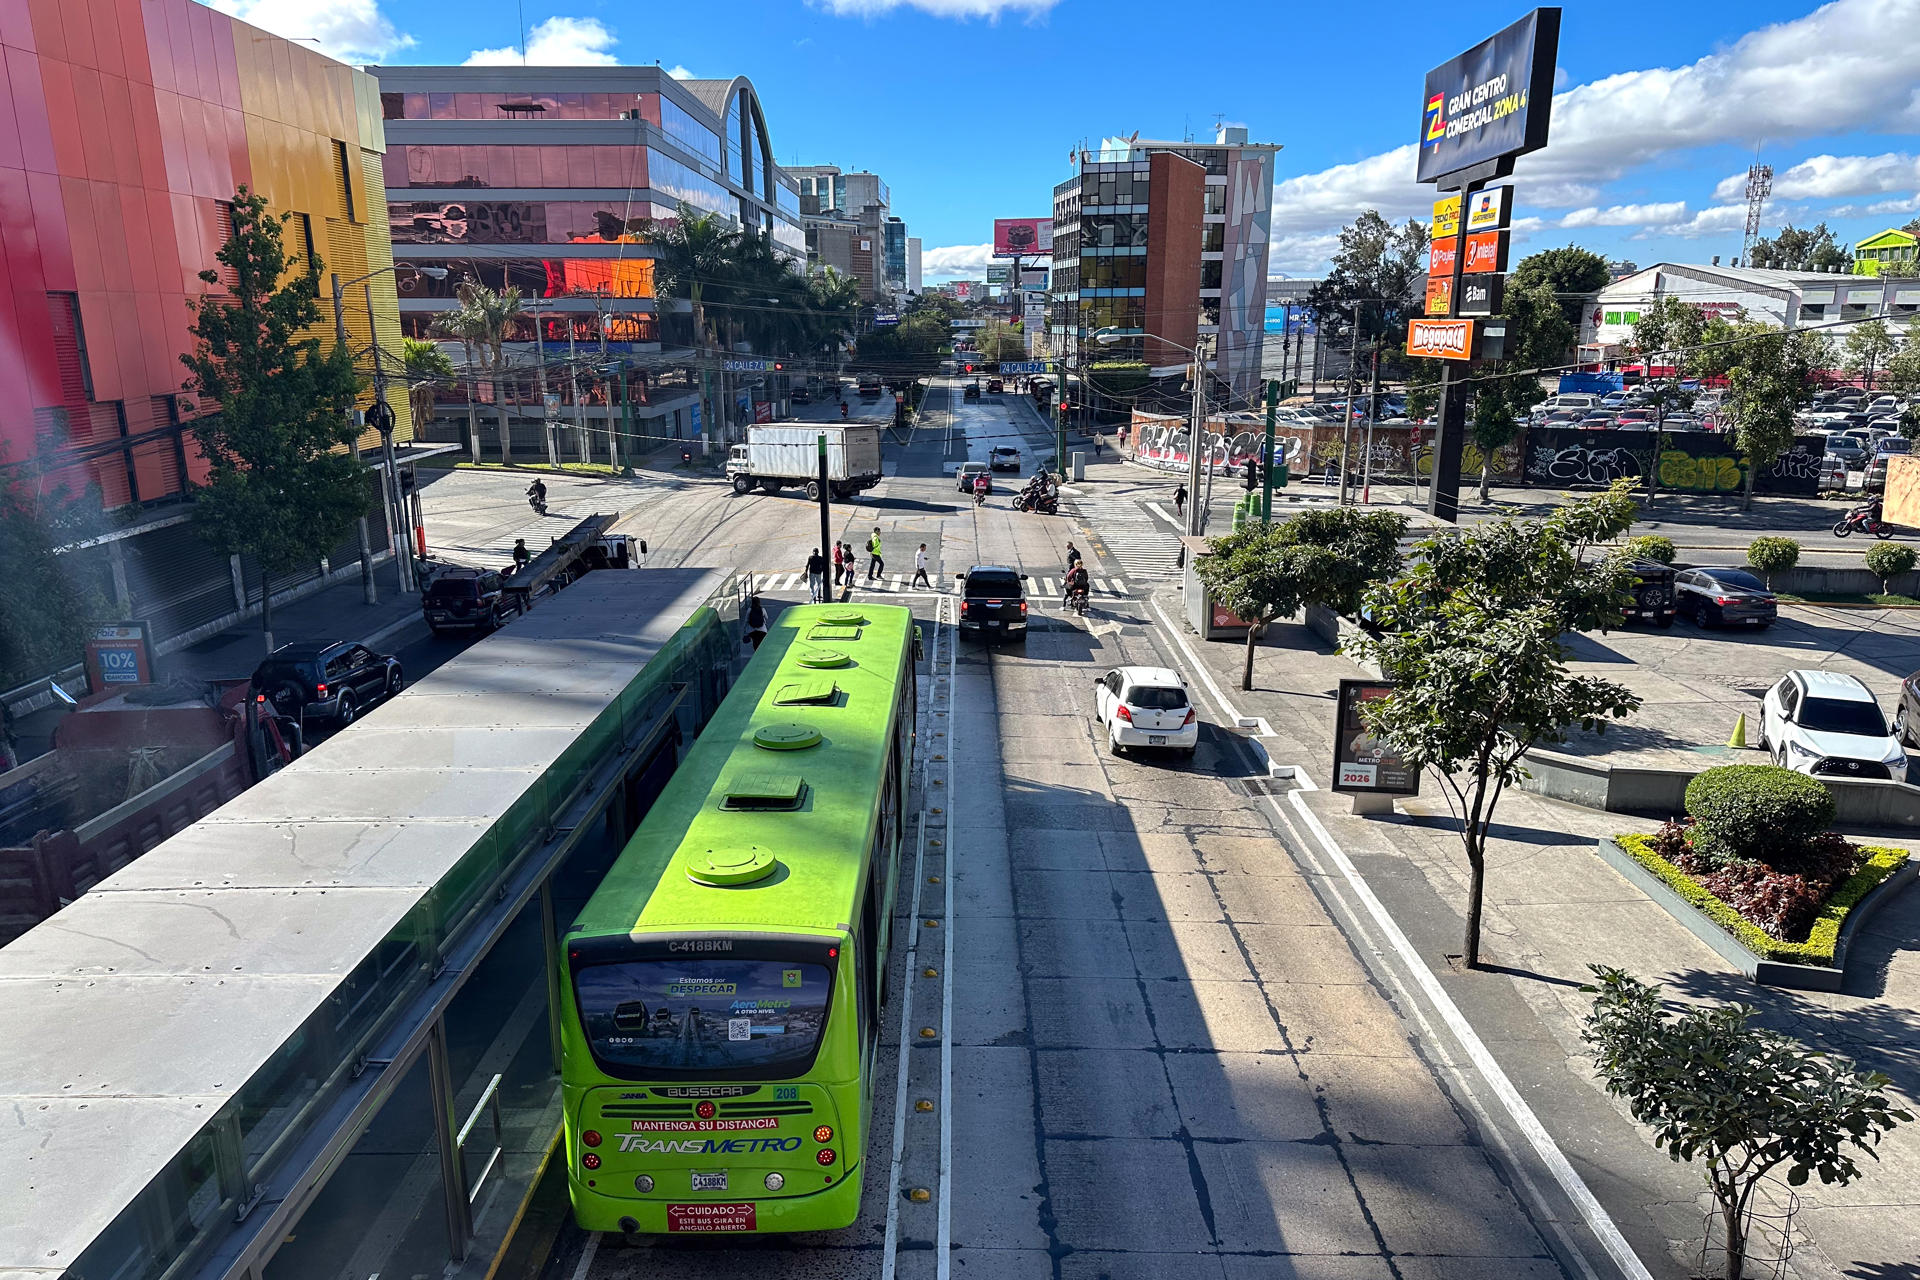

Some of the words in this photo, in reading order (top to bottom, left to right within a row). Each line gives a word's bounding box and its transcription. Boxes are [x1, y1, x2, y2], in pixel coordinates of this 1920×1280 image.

[1448, 91, 1471, 116] GRAN
[1472, 73, 1507, 106] CENTRO
[1446, 107, 1493, 139] COMERCIAL
[1492, 92, 1519, 121] ZONA
[1519, 88, 1527, 109] 4
[1472, 285, 1487, 301] Bam
[1413, 323, 1466, 353] megapaca
[1001, 362, 1010, 374] 24
[1011, 362, 1033, 374] CALLE
[97, 628, 116, 637] Paiz
[101, 652, 135, 668] 10%
[1343, 774, 1370, 783] 2026
[669, 940, 733, 952] C-418BKM
[671, 984, 734, 993] DESPEGAR
[730, 999, 791, 1009] AeroMetro
[667, 1086, 743, 1097] BUSSCAR
[776, 1087, 797, 1099] 208
[632, 1121, 697, 1131] MANTENGA
[699, 1121, 714, 1130] SU
[716, 1118, 777, 1130] DISTANCIA
[687, 1206, 736, 1215] CUIDADO
[713, 1216, 733, 1224] GIRA
